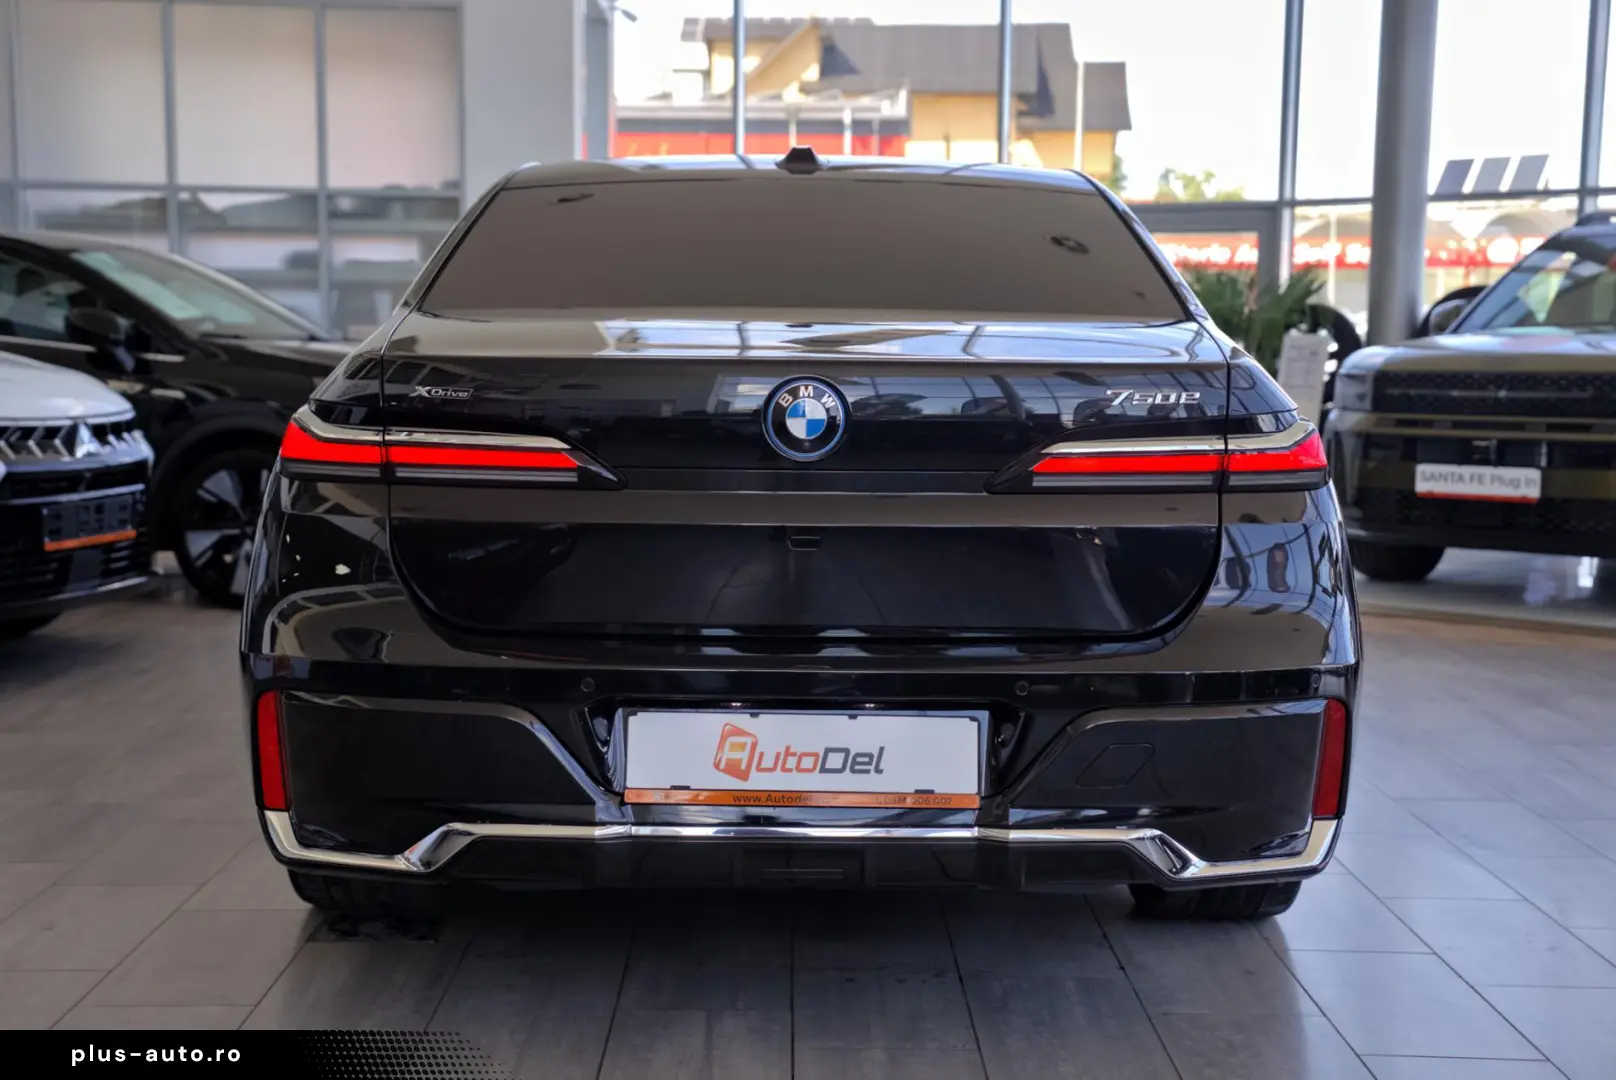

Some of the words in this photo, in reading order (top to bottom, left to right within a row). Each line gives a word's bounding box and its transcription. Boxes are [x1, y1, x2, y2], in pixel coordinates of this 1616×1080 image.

[778, 385, 836, 408] BMW
[1105, 389, 1200, 406] 750e
[1419, 469, 1467, 486] SANTA
[1469, 472, 1486, 486] FE
[1490, 473, 1522, 491] Plug
[714, 723, 886, 781] AutoDel
